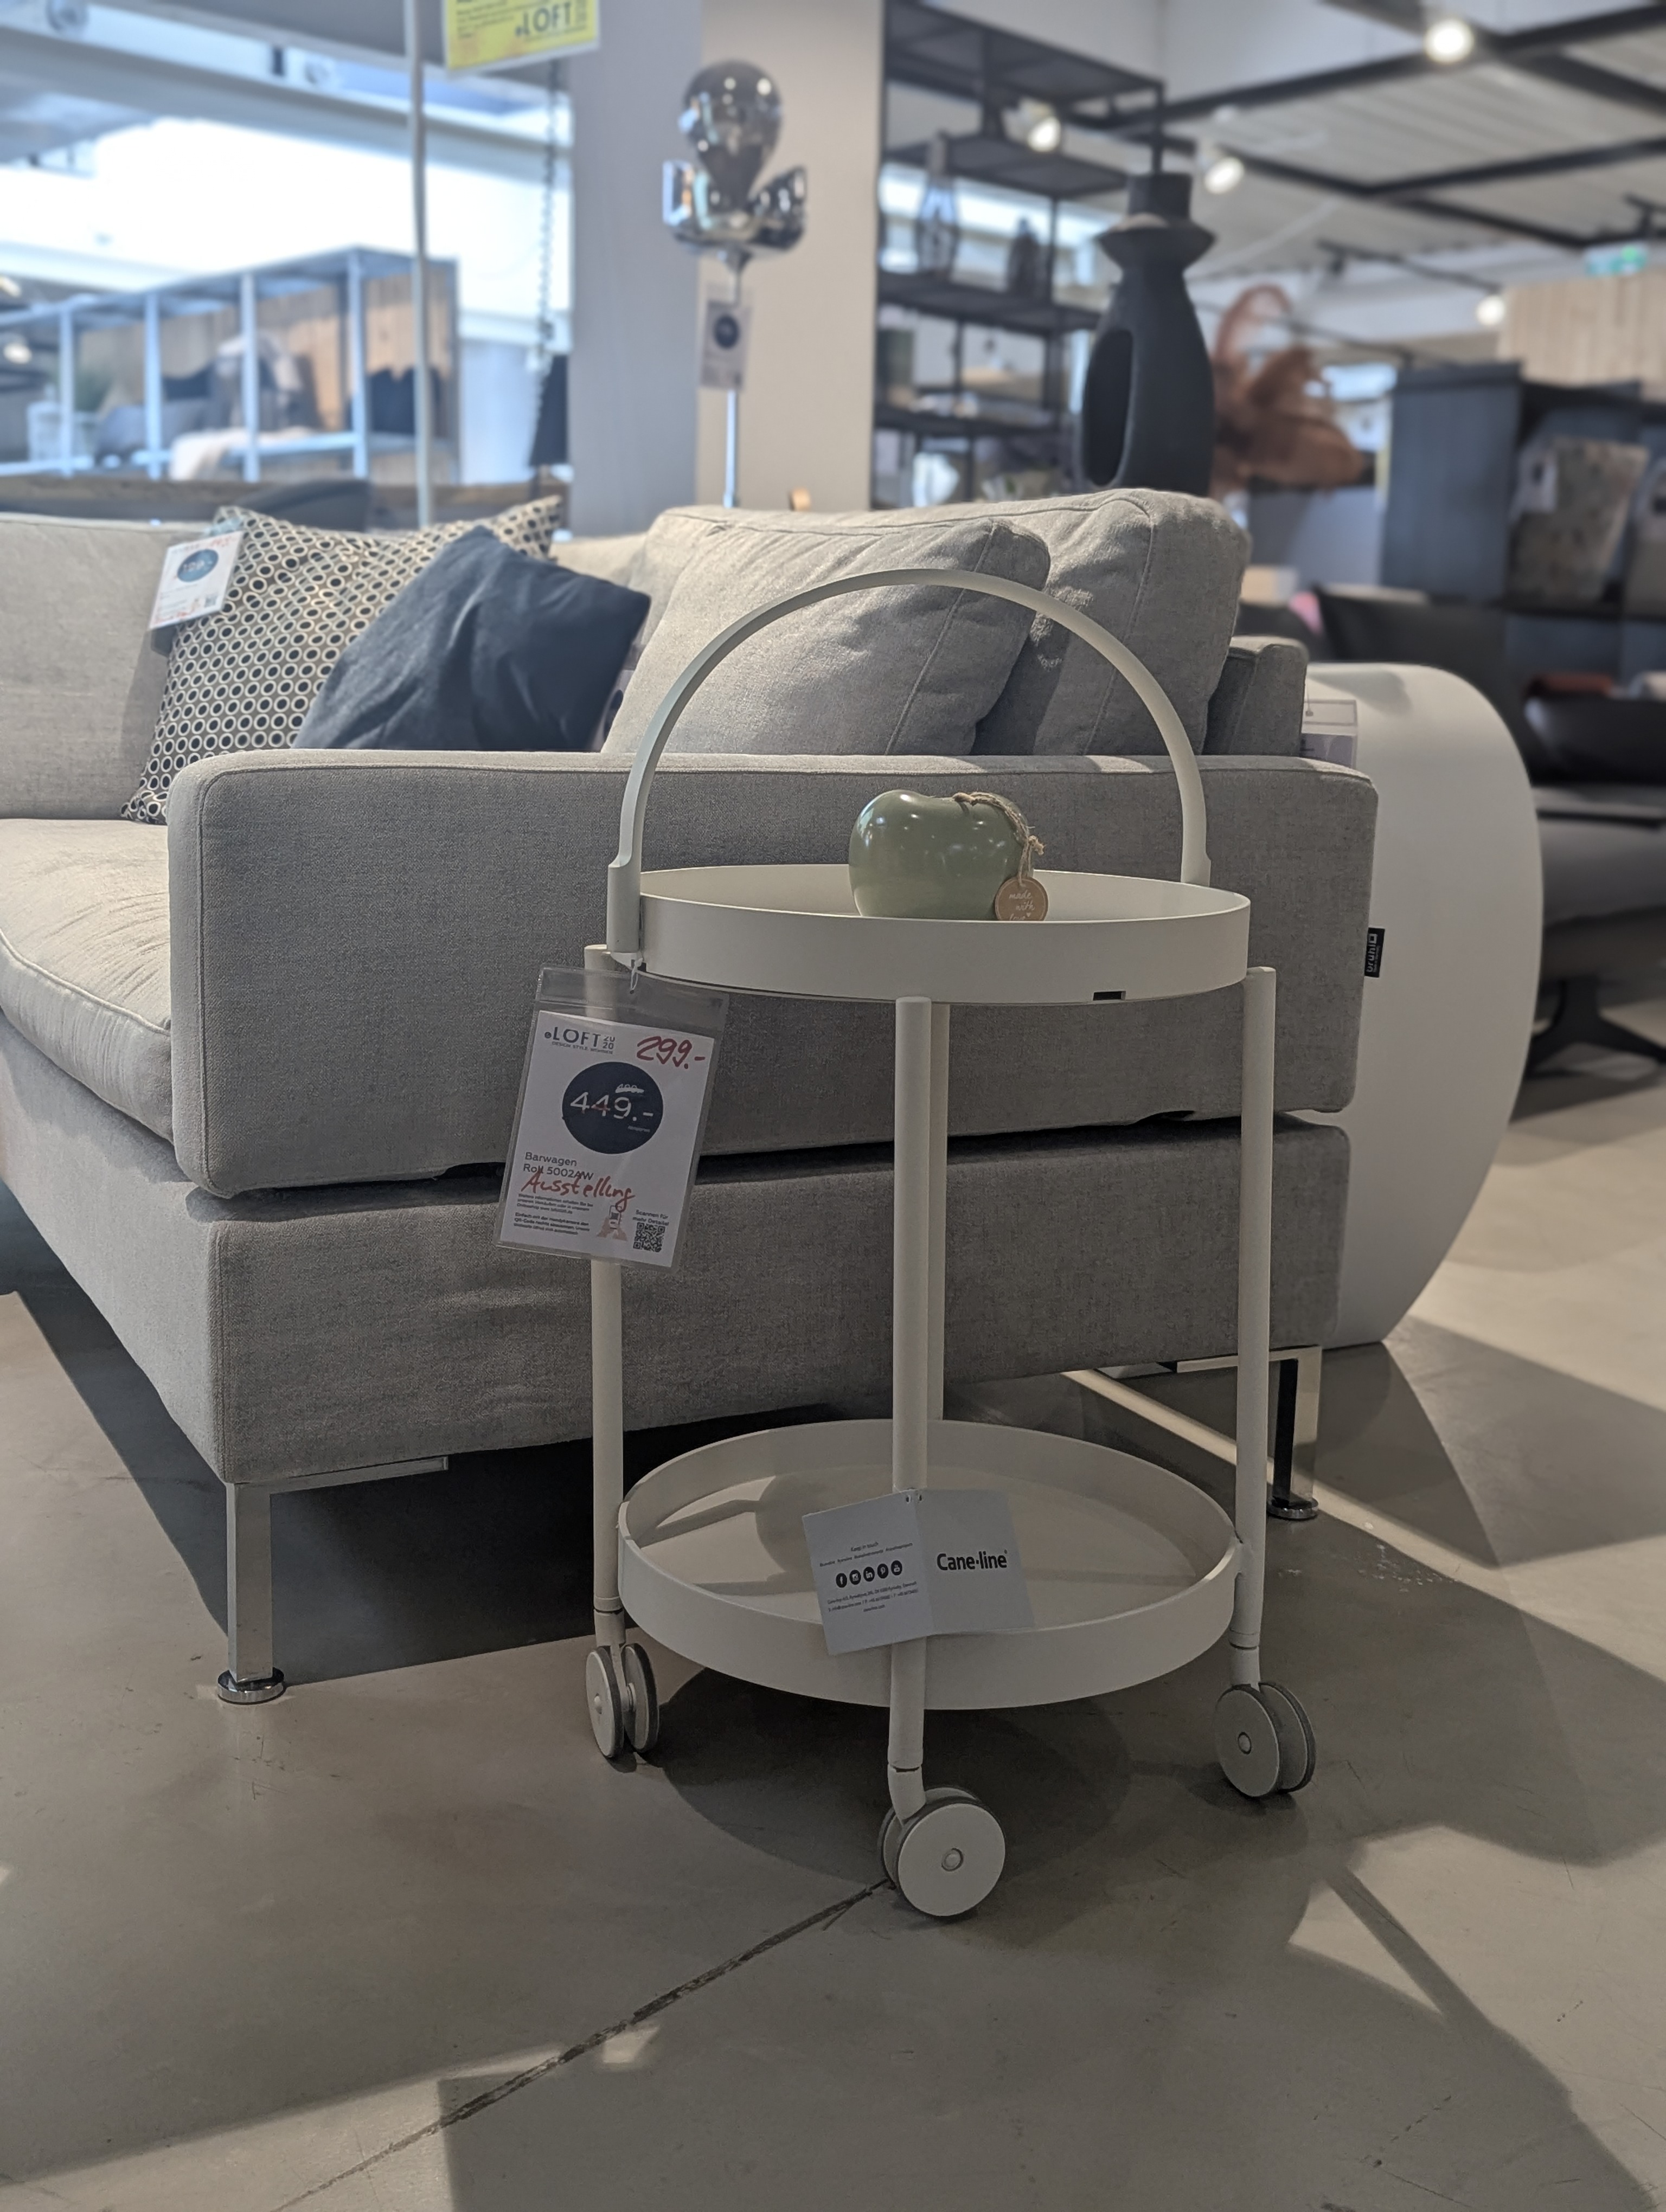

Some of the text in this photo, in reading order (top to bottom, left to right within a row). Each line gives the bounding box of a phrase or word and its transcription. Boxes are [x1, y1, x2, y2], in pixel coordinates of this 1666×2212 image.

[553, 1026, 601, 1047] LOFT
[570, 1091, 653, 1121] 449.-
[525, 1152, 577, 1166] Barwagen
[937, 1551, 1007, 1571] Cane-line
